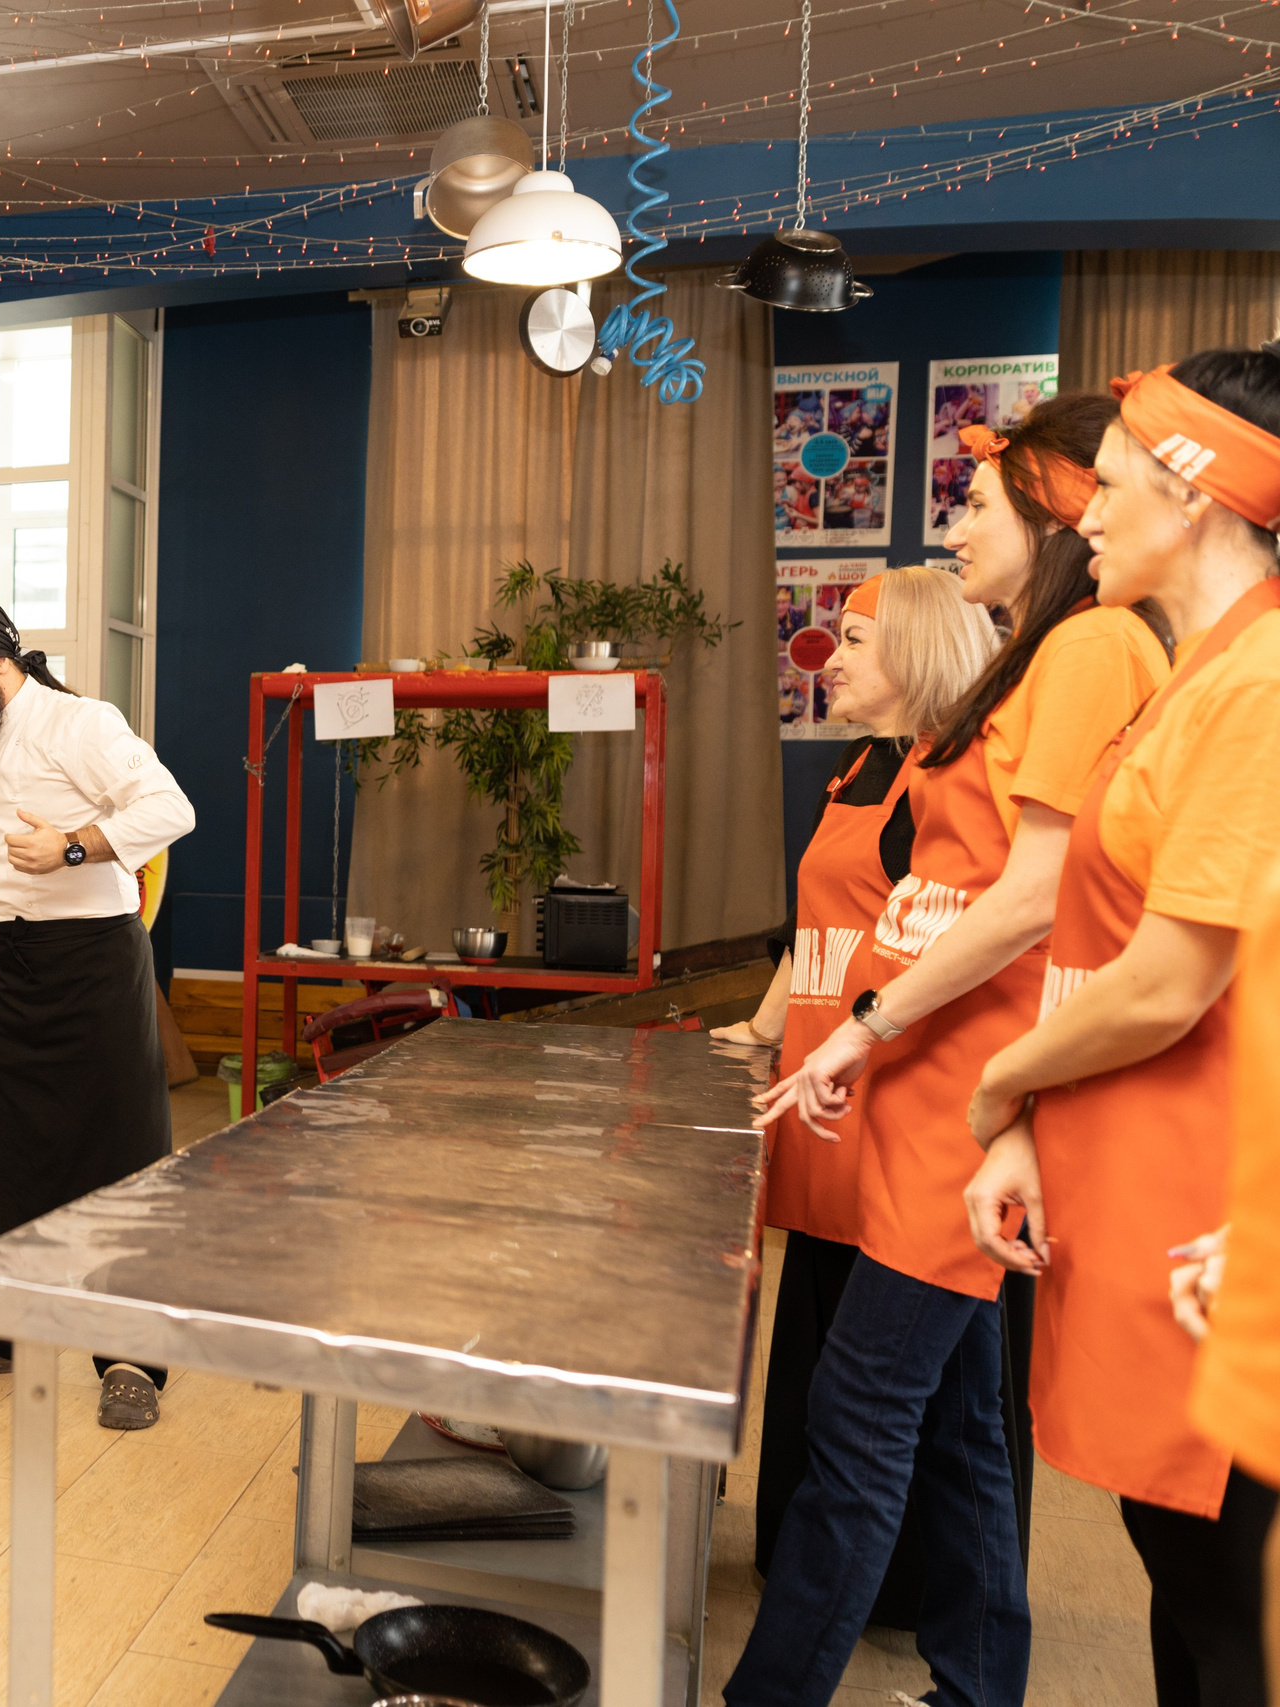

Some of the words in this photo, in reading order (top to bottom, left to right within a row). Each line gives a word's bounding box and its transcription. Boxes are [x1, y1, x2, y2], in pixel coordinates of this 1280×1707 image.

[776, 367, 879, 385] ВЫПУСКНОЙ
[943, 361, 1056, 378] КОРПОРАТИВ
[820, 927, 865, 997] RUN
